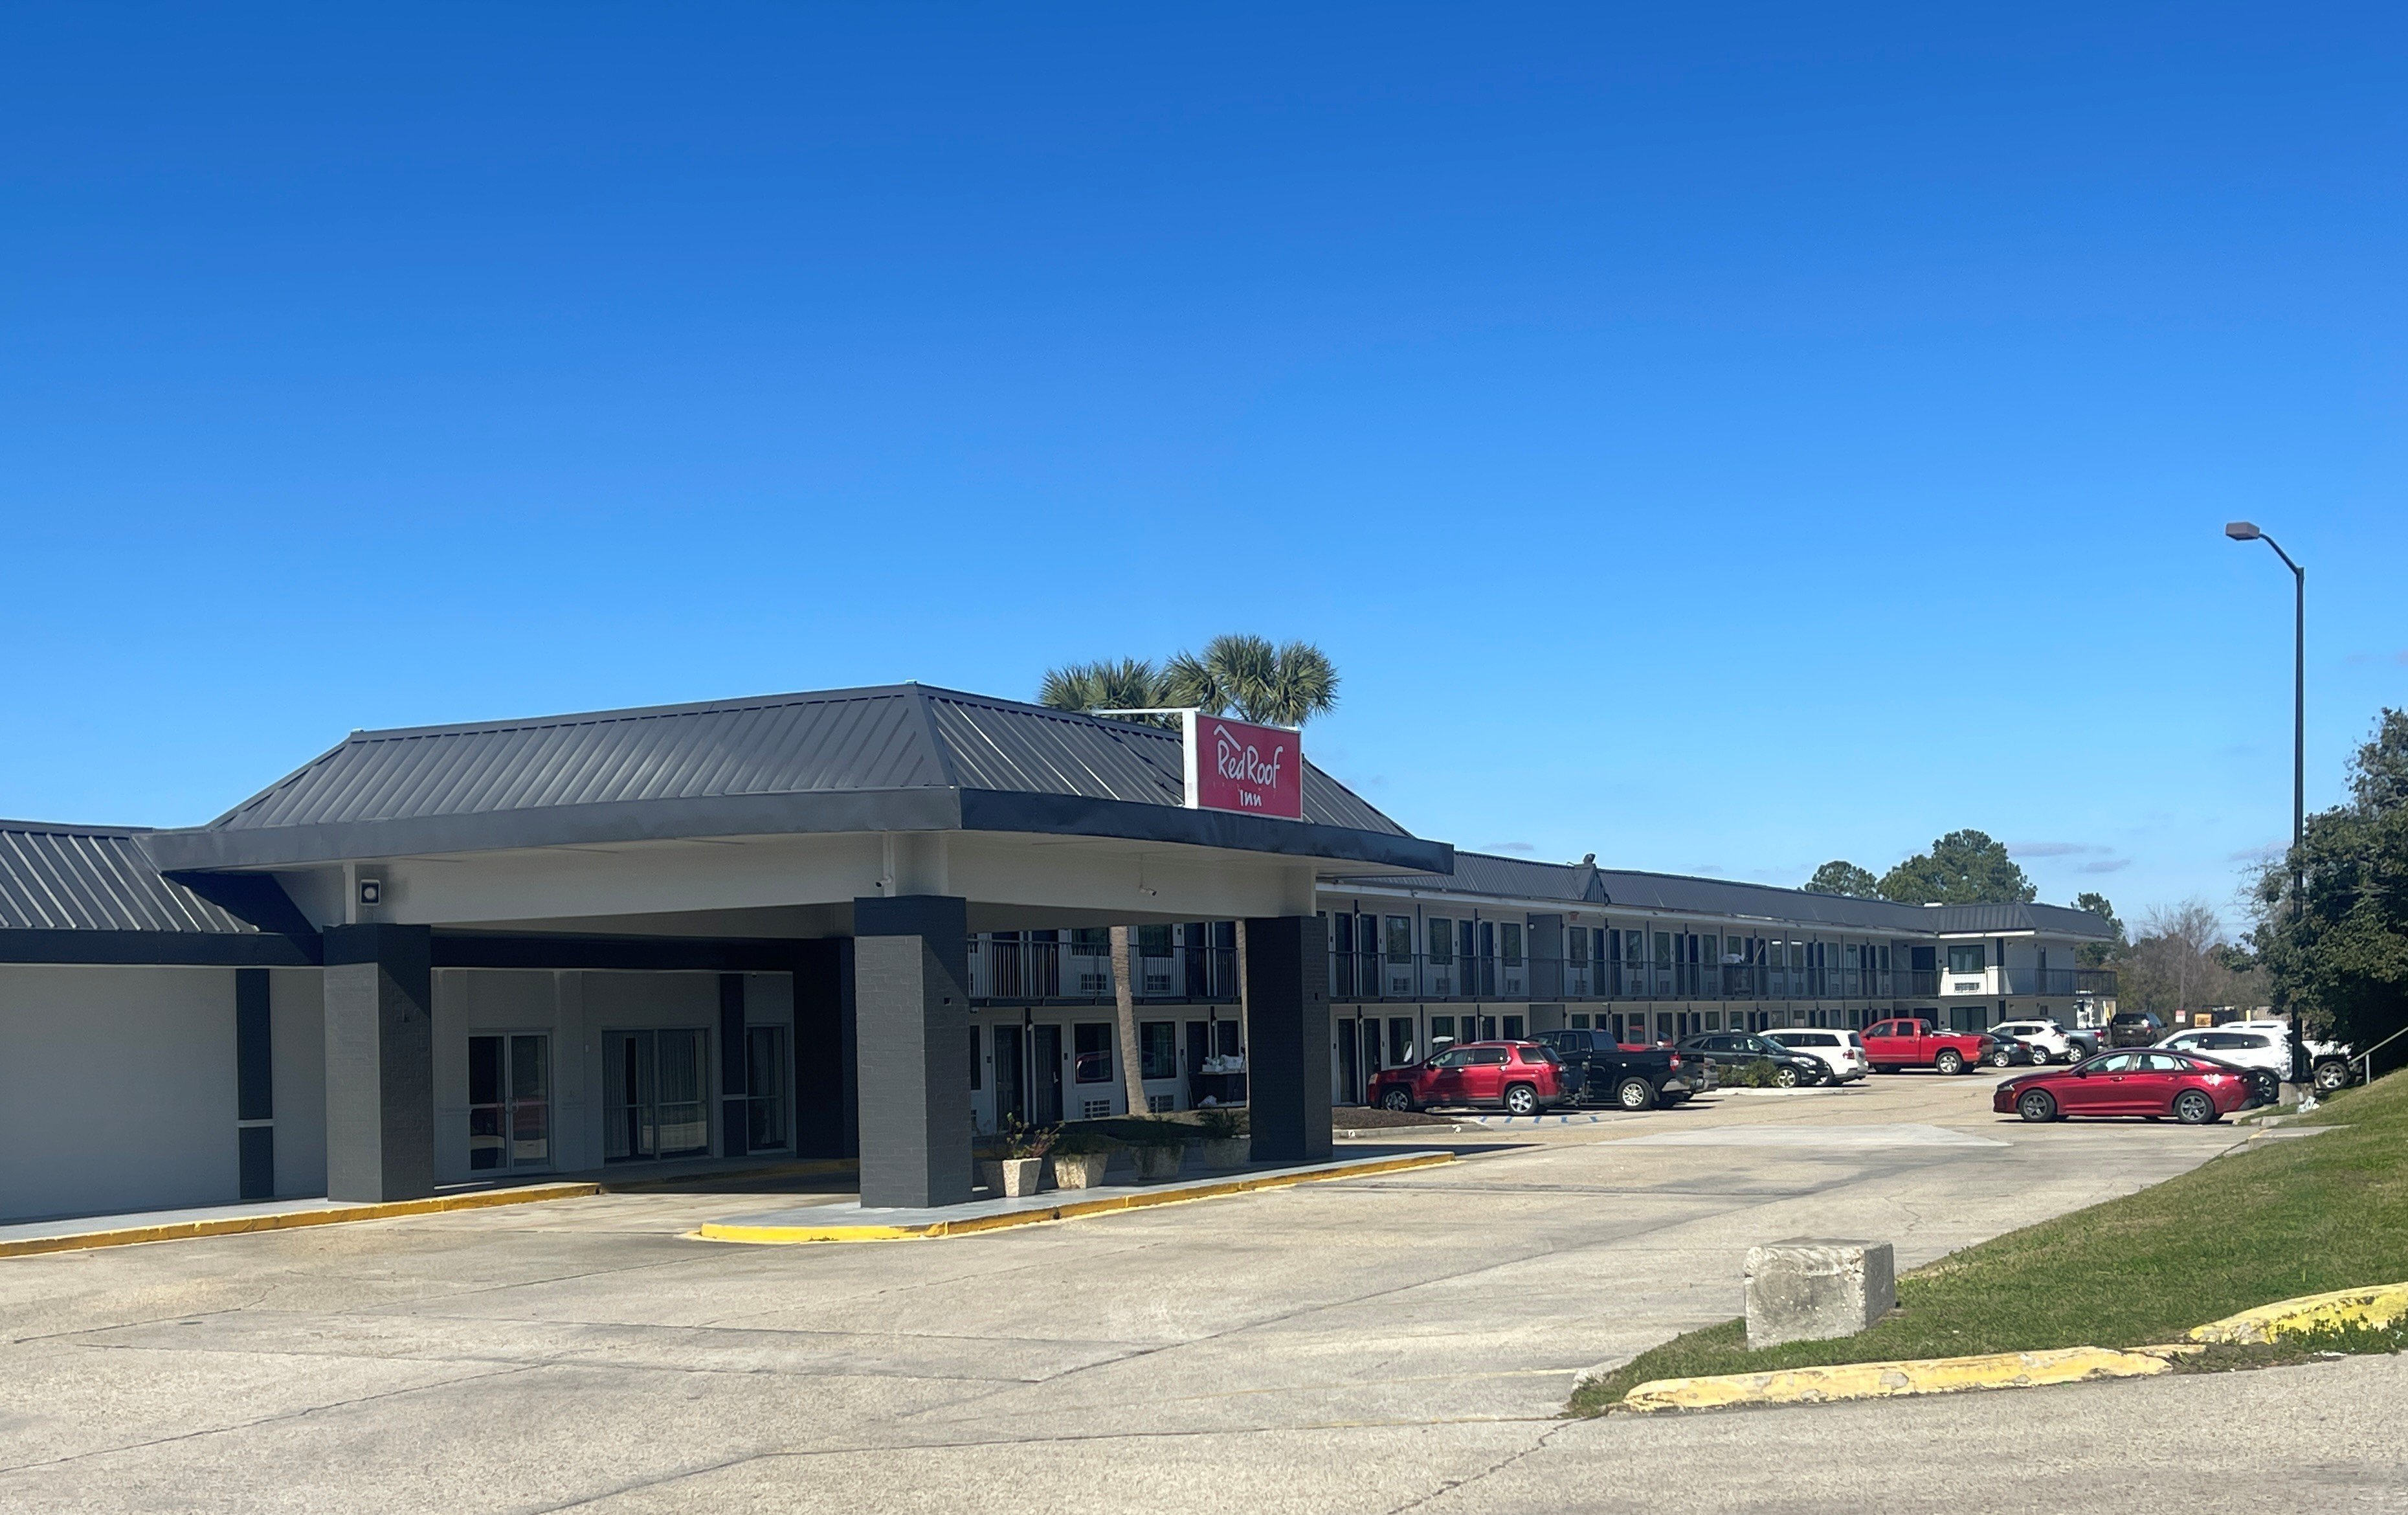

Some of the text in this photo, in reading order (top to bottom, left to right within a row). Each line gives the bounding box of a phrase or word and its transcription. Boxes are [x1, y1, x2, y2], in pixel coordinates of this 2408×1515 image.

[1218, 739, 1284, 789] Red Roof
[1240, 789, 1262, 807] Inn
